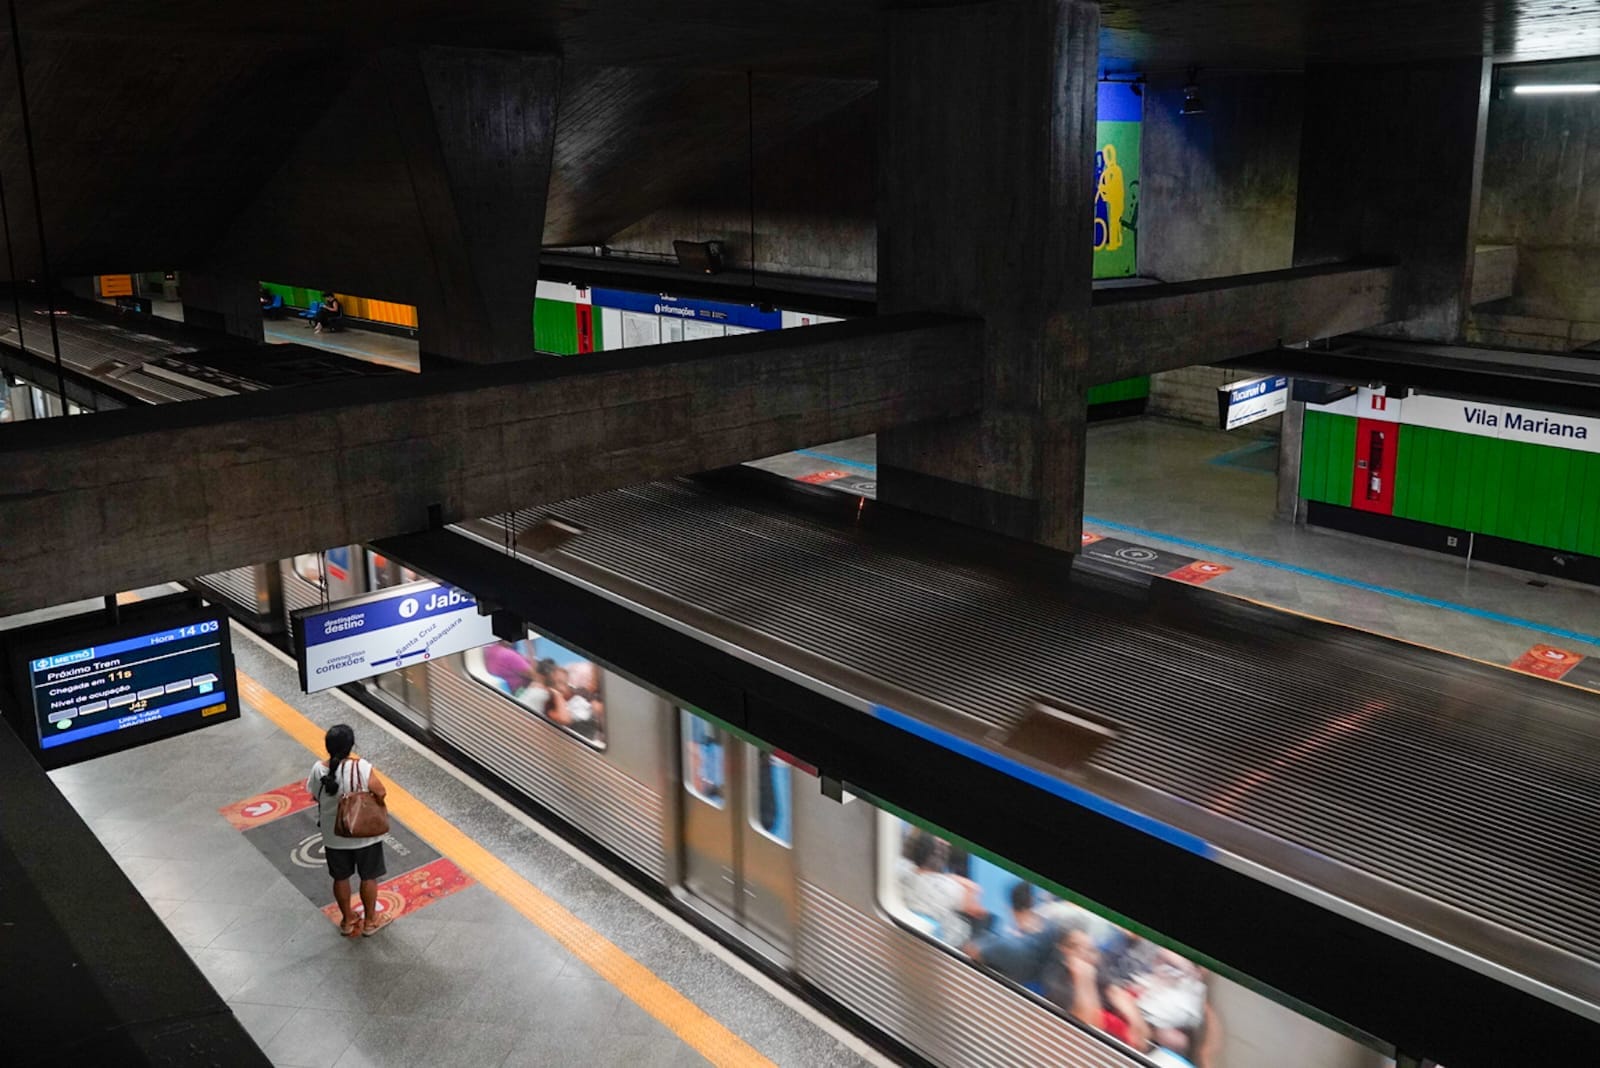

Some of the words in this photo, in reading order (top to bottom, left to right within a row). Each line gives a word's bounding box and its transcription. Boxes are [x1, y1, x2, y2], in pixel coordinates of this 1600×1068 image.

[1464, 406, 1498, 427] Vila
[1504, 412, 1587, 439] Mariana
[150, 634, 175, 645] Hora
[179, 626, 196, 638] 14
[200, 620, 219, 633] 03
[325, 619, 364, 635] destino
[425, 617, 463, 649] Jabaquara
[395, 636, 419, 655] Santa
[418, 622, 437, 639] Cruz
[54, 651, 90, 665] METRÔ
[316, 655, 366, 674] conexões
[47, 665, 92, 681] Próximo
[93, 659, 121, 671] Trem
[49, 682, 90, 696] Chegada
[91, 678, 106, 686] em
[75, 695, 88, 703] de
[88, 684, 131, 700] ocupação
